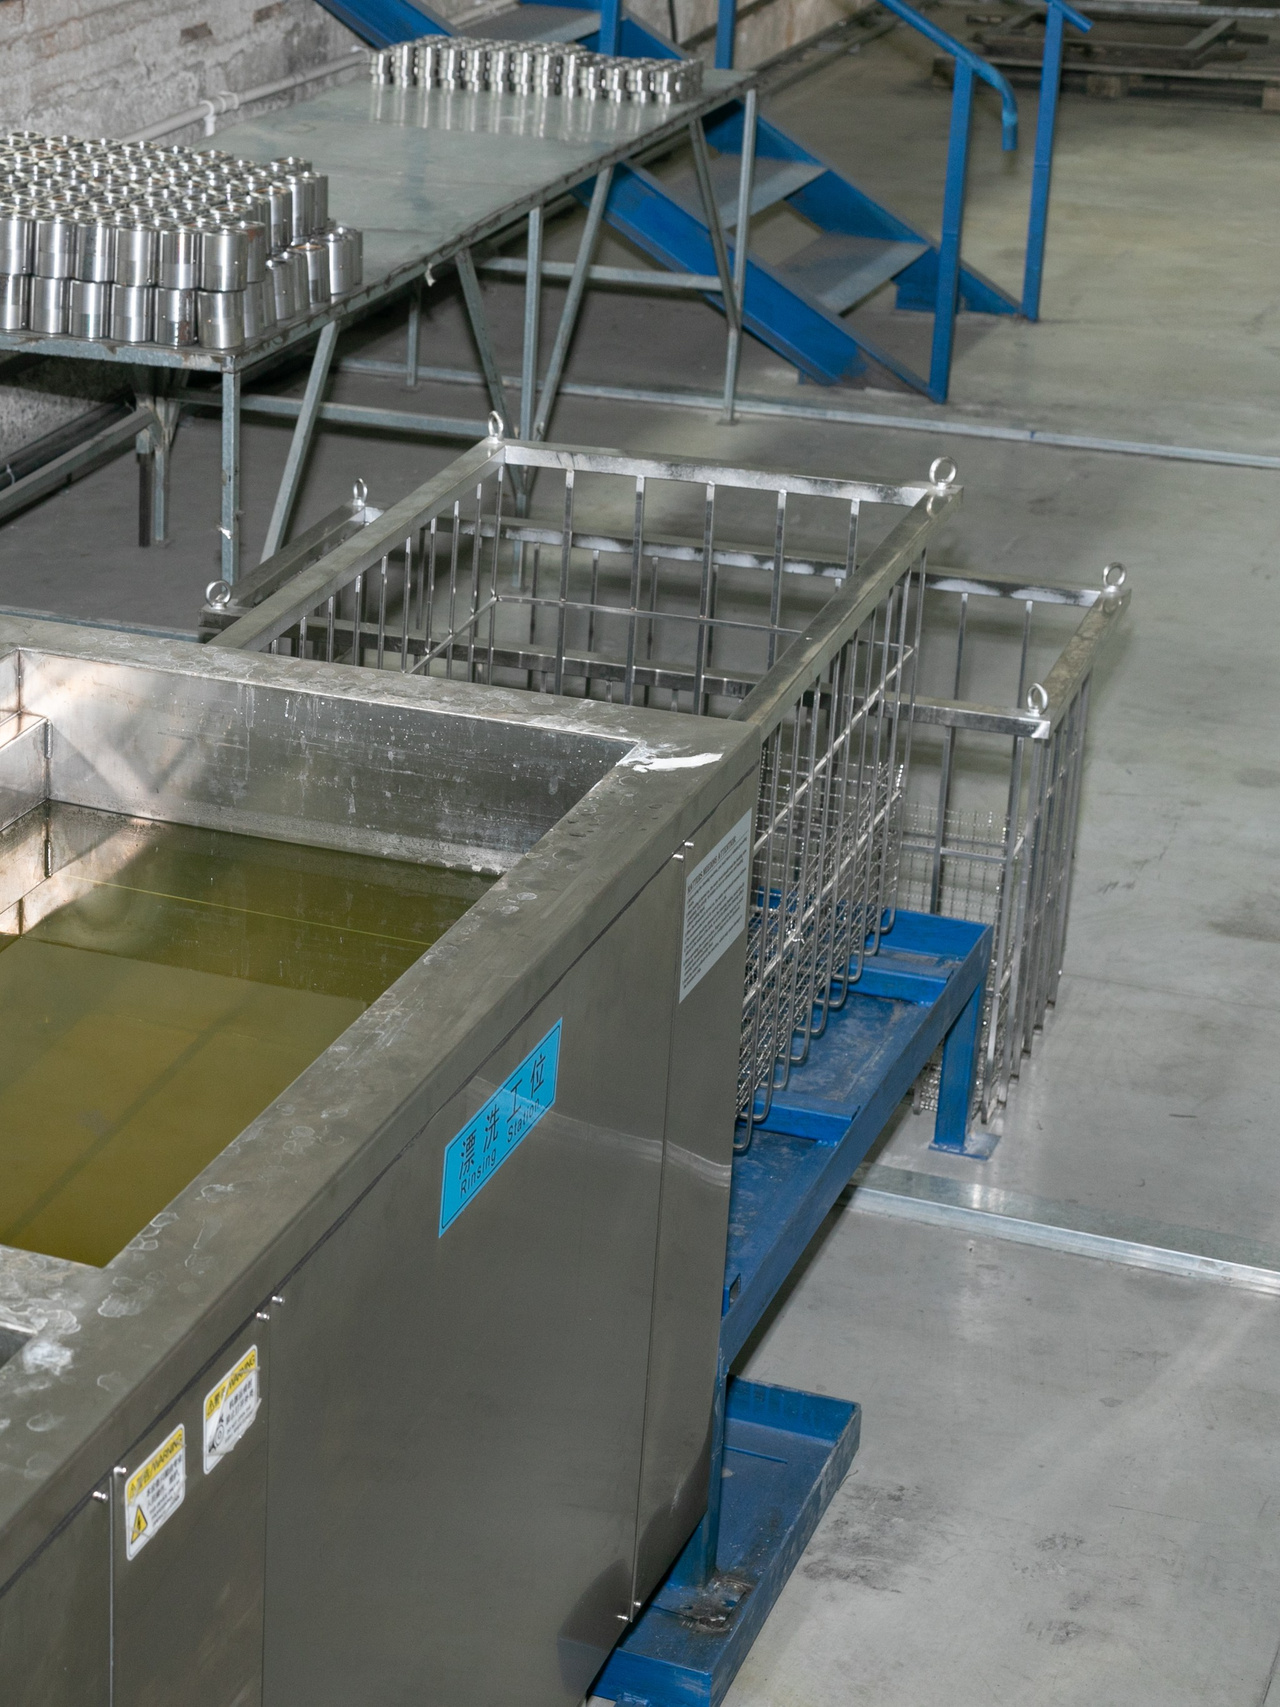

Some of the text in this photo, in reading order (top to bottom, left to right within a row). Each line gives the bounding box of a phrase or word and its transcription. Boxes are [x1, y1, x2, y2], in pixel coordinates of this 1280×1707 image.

[459, 1053, 546, 1180] 漂洗工位
[460, 1098, 540, 1199] Rinsing Station
